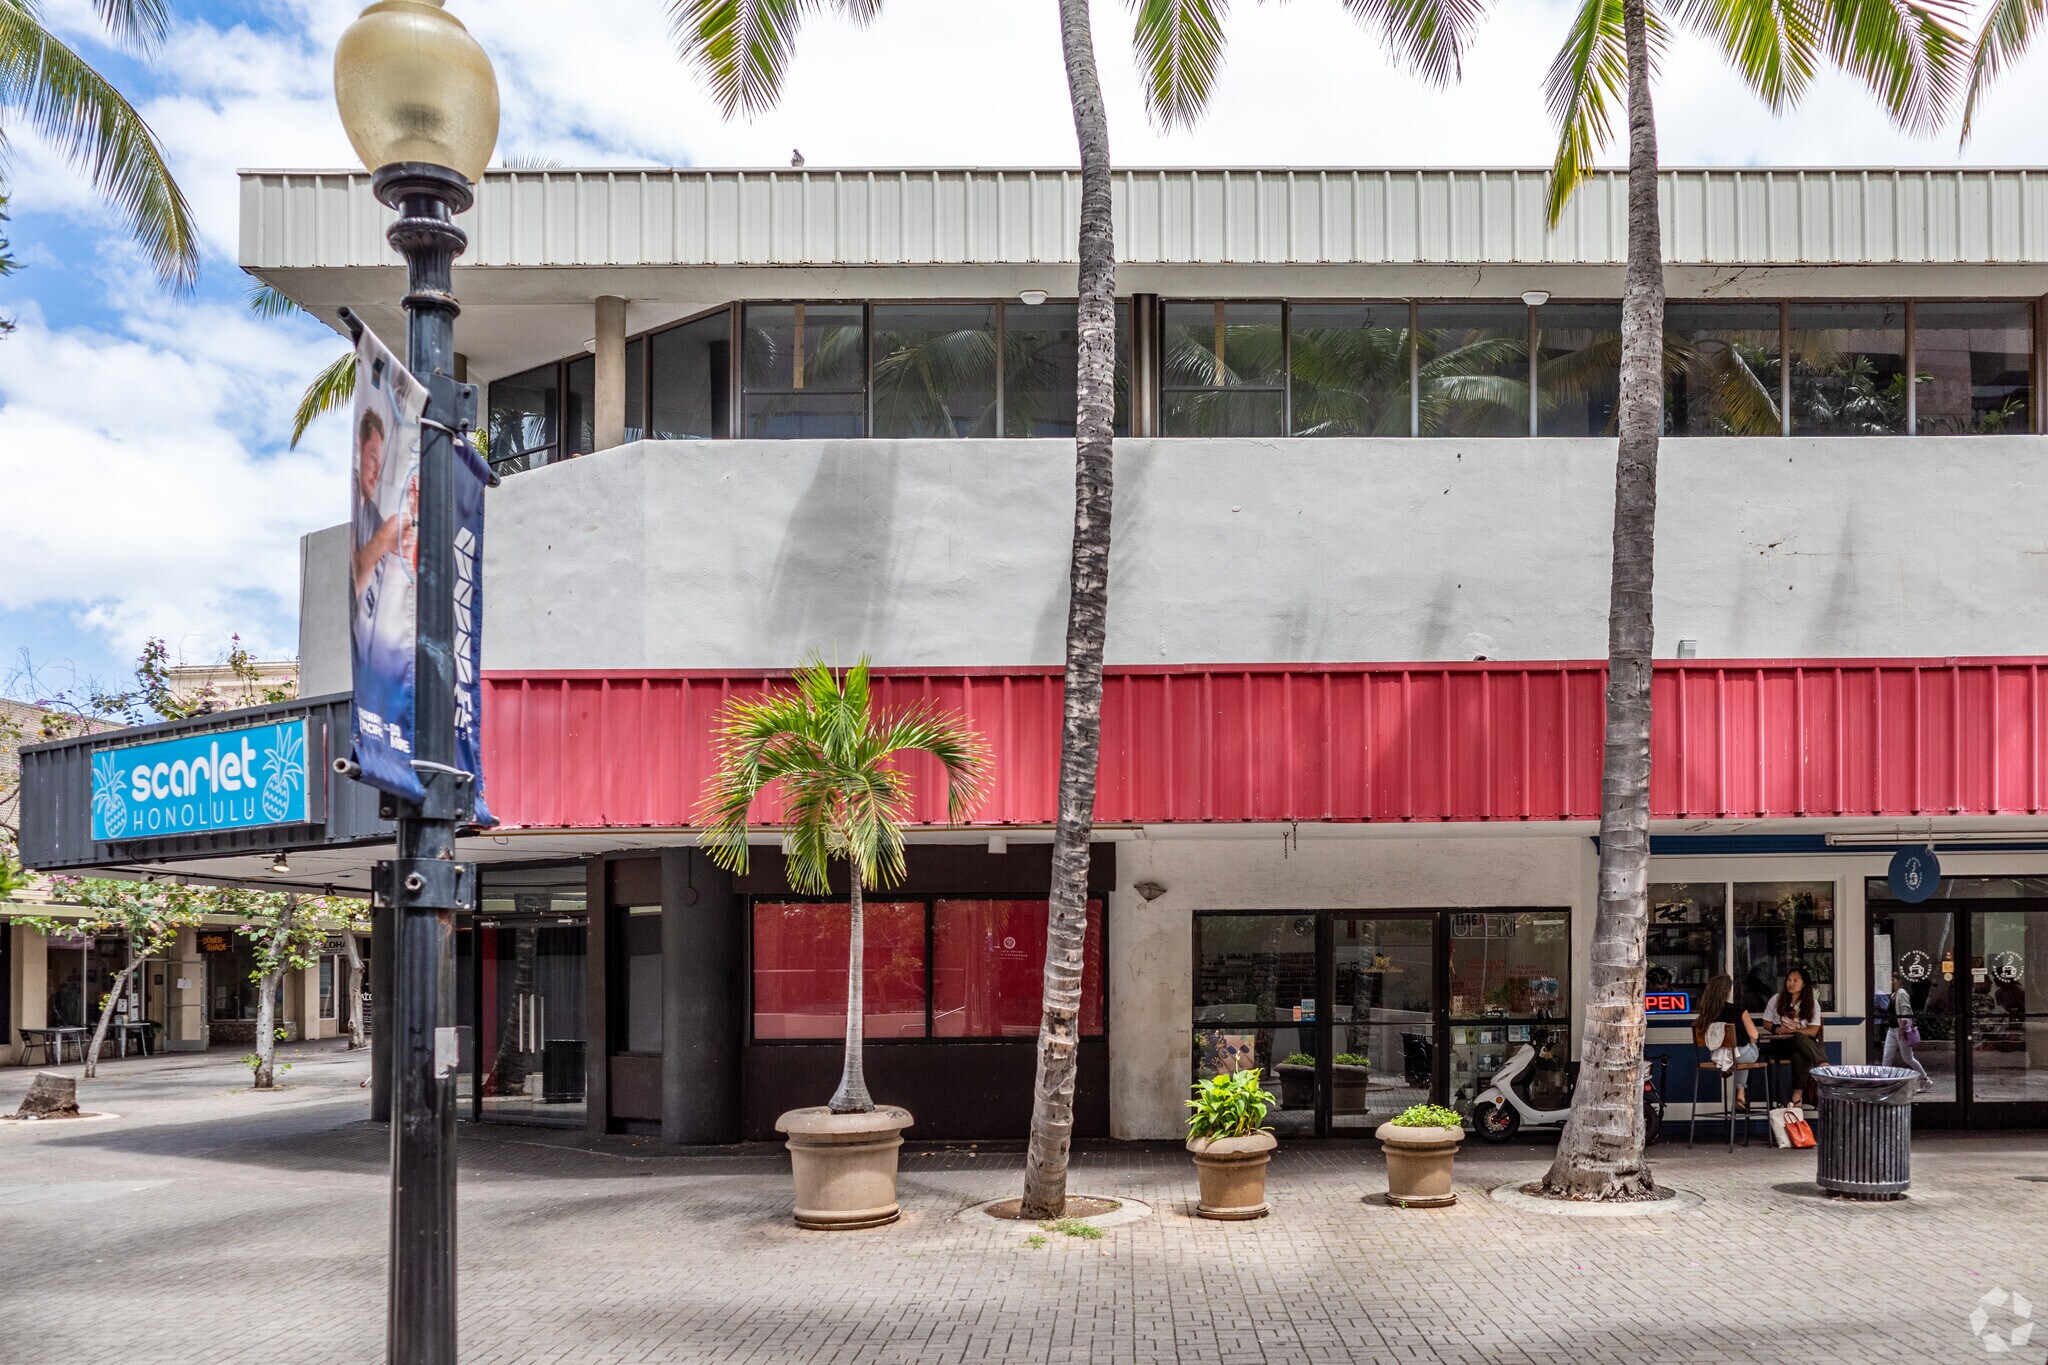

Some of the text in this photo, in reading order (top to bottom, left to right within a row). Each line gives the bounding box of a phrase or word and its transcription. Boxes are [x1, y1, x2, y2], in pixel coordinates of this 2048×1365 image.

[131, 736, 257, 802] scarlet
[133, 797, 255, 831] HONOLULU
[1900, 950, 1930, 962] DRIP STUDIO
[2006, 950, 2023, 961] STUDIO
[1645, 996, 1686, 1010] PEN
